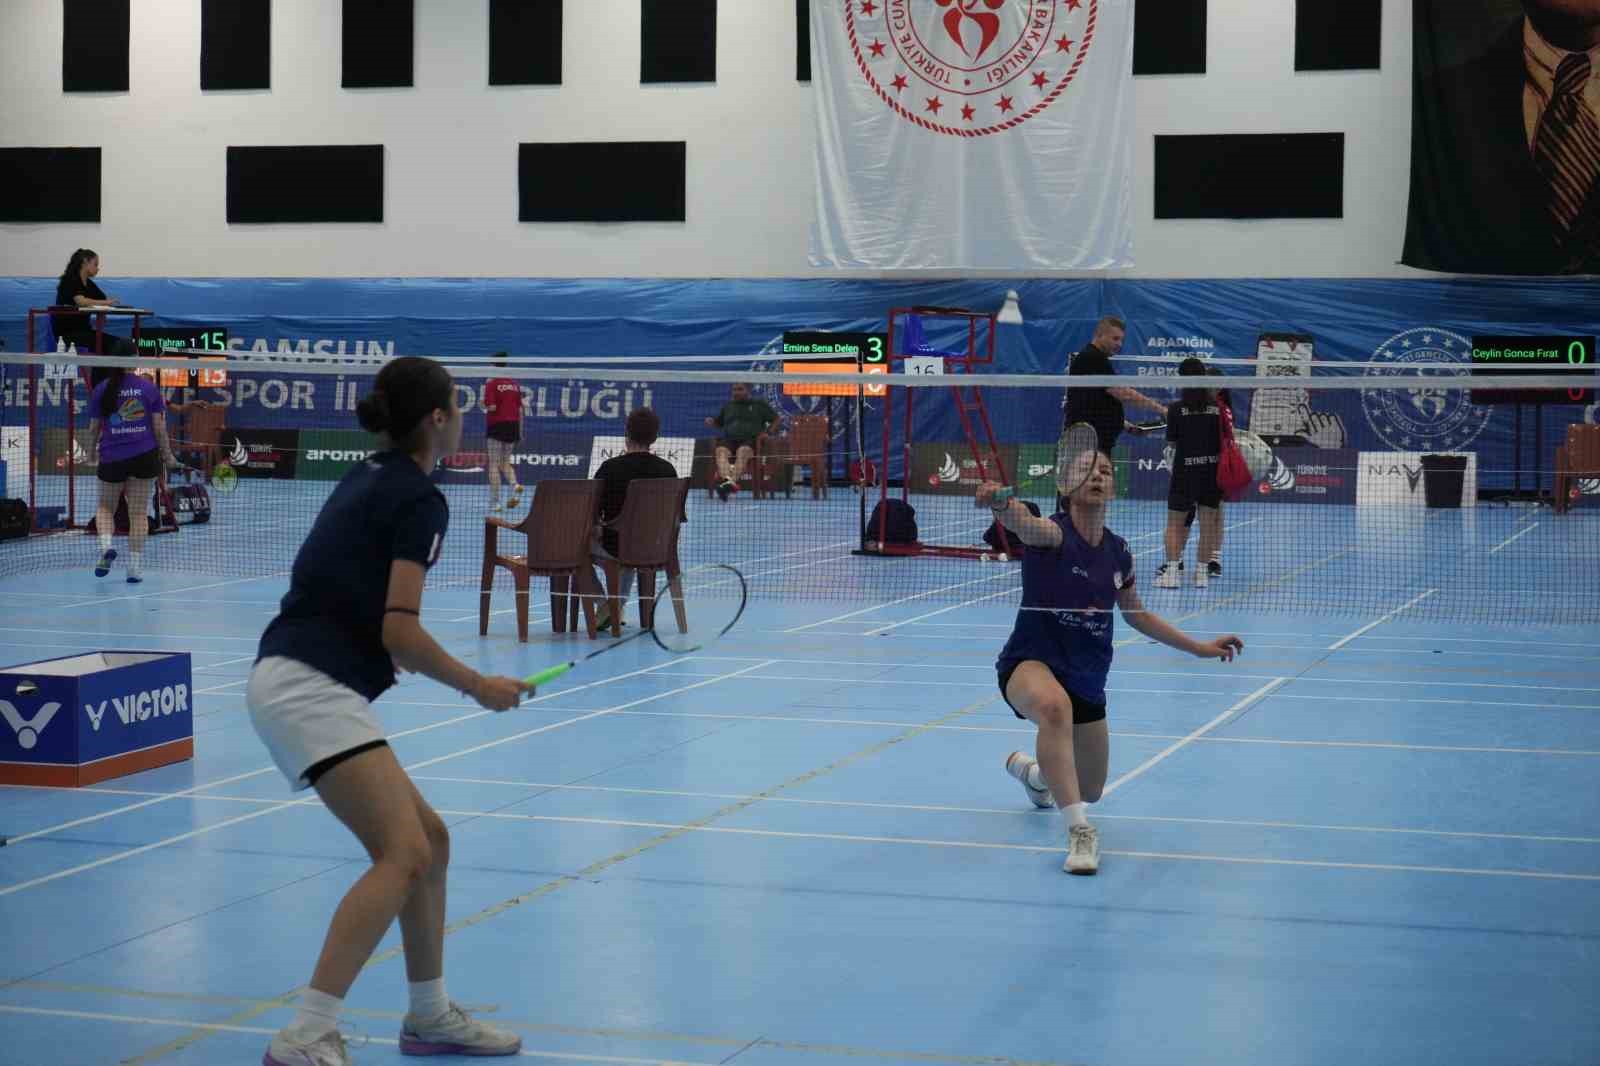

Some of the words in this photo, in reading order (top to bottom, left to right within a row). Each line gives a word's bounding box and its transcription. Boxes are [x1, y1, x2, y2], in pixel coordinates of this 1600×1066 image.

[201, 332, 225, 353] 15
[226, 338, 396, 363] SAMSUN
[784, 344, 810, 353] Emine
[867, 337, 883, 362] 3
[1147, 335, 1214, 348] ARADIĞIN
[1472, 348, 1501, 360] Ceylin
[1504, 348, 1534, 358] Gonca
[1568, 341, 1585, 365] 0
[305, 449, 376, 461] arom
[112, 684, 188, 725] VICTOR
